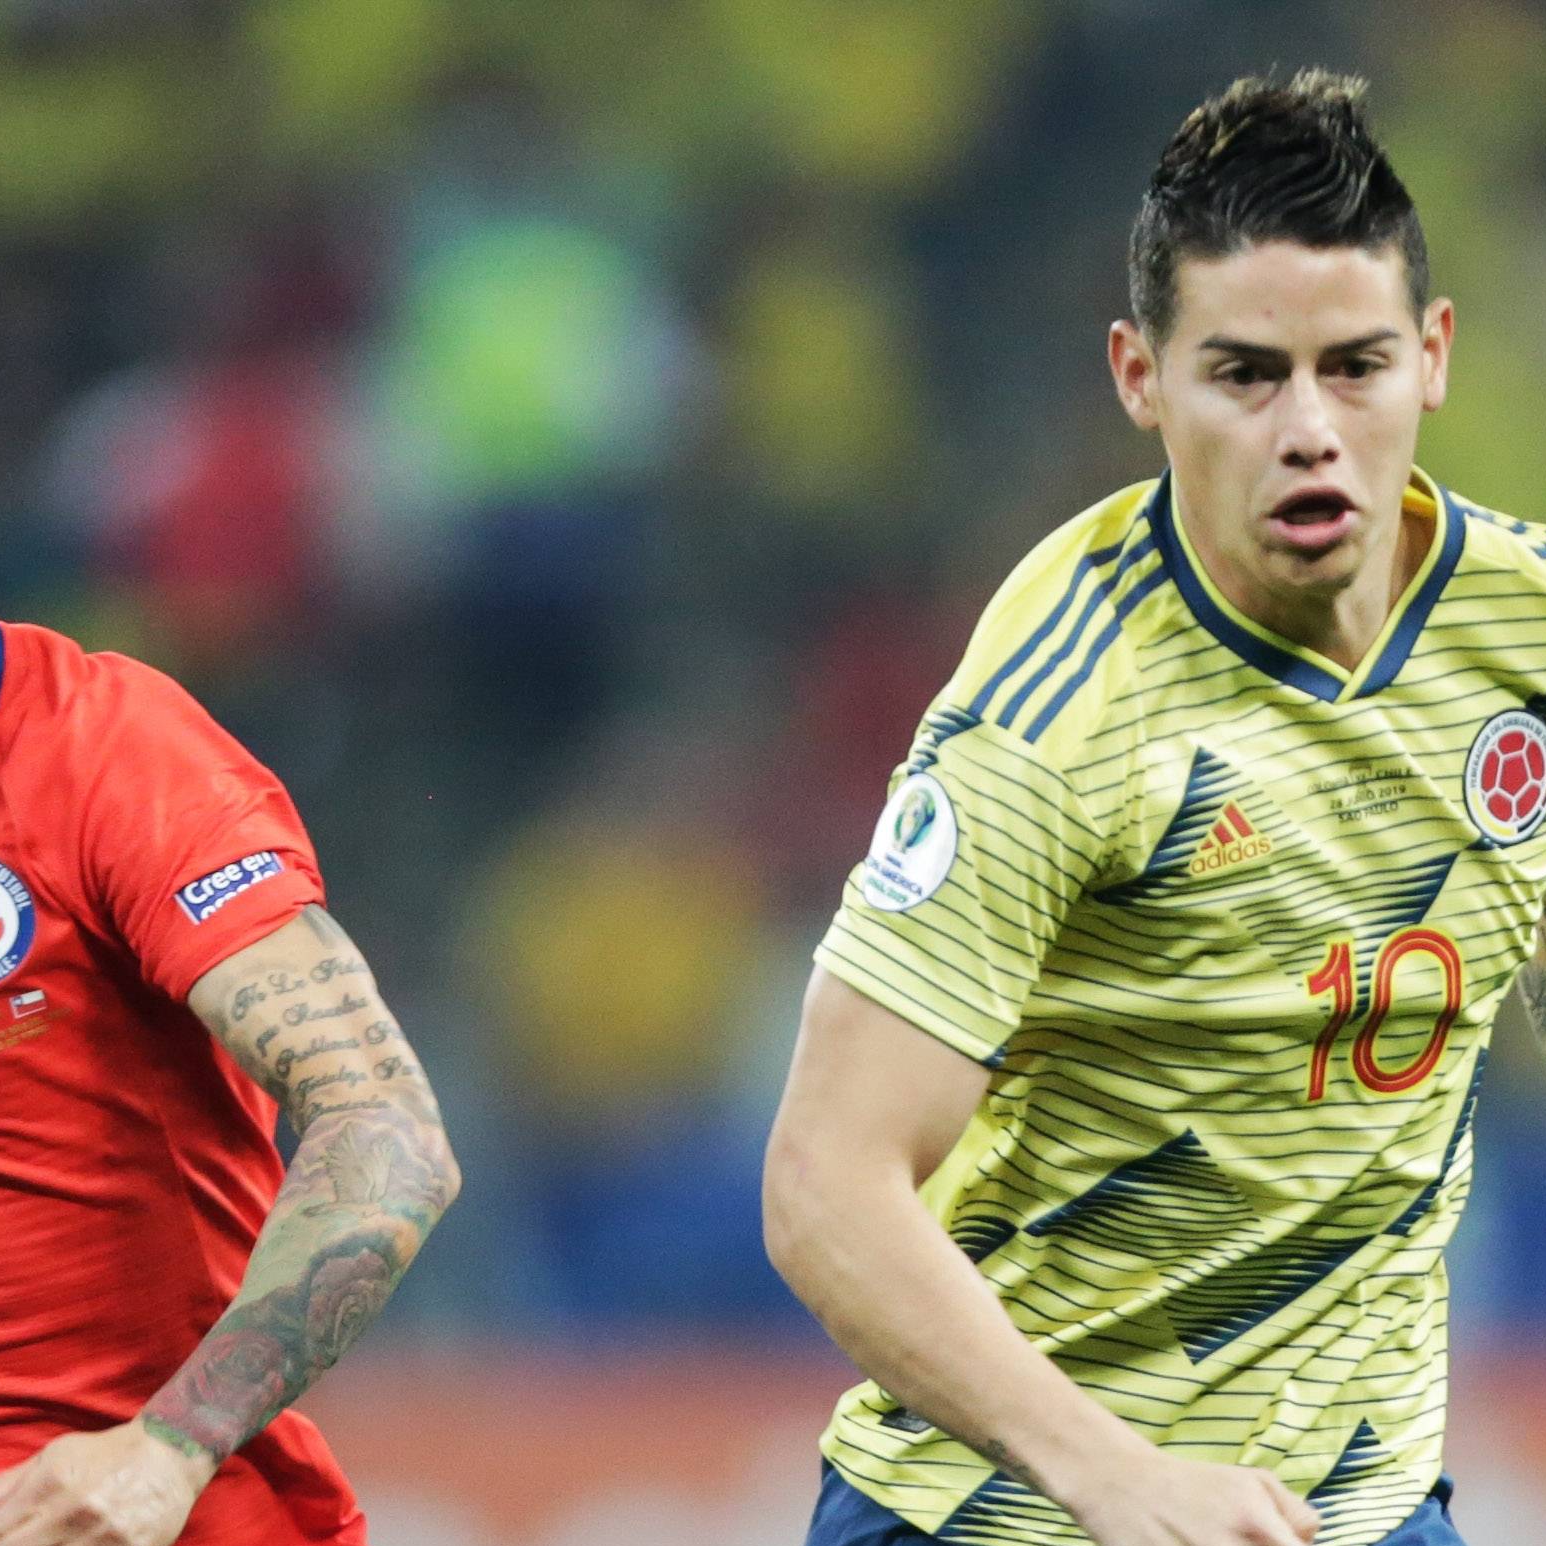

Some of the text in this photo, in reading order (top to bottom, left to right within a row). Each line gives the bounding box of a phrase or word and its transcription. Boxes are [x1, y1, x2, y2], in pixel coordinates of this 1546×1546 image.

[184, 863, 244, 904] Cree
[241, 851, 272, 872] en
[1191, 838, 1271, 874] adidas
[1306, 928, 1462, 1102] 10
